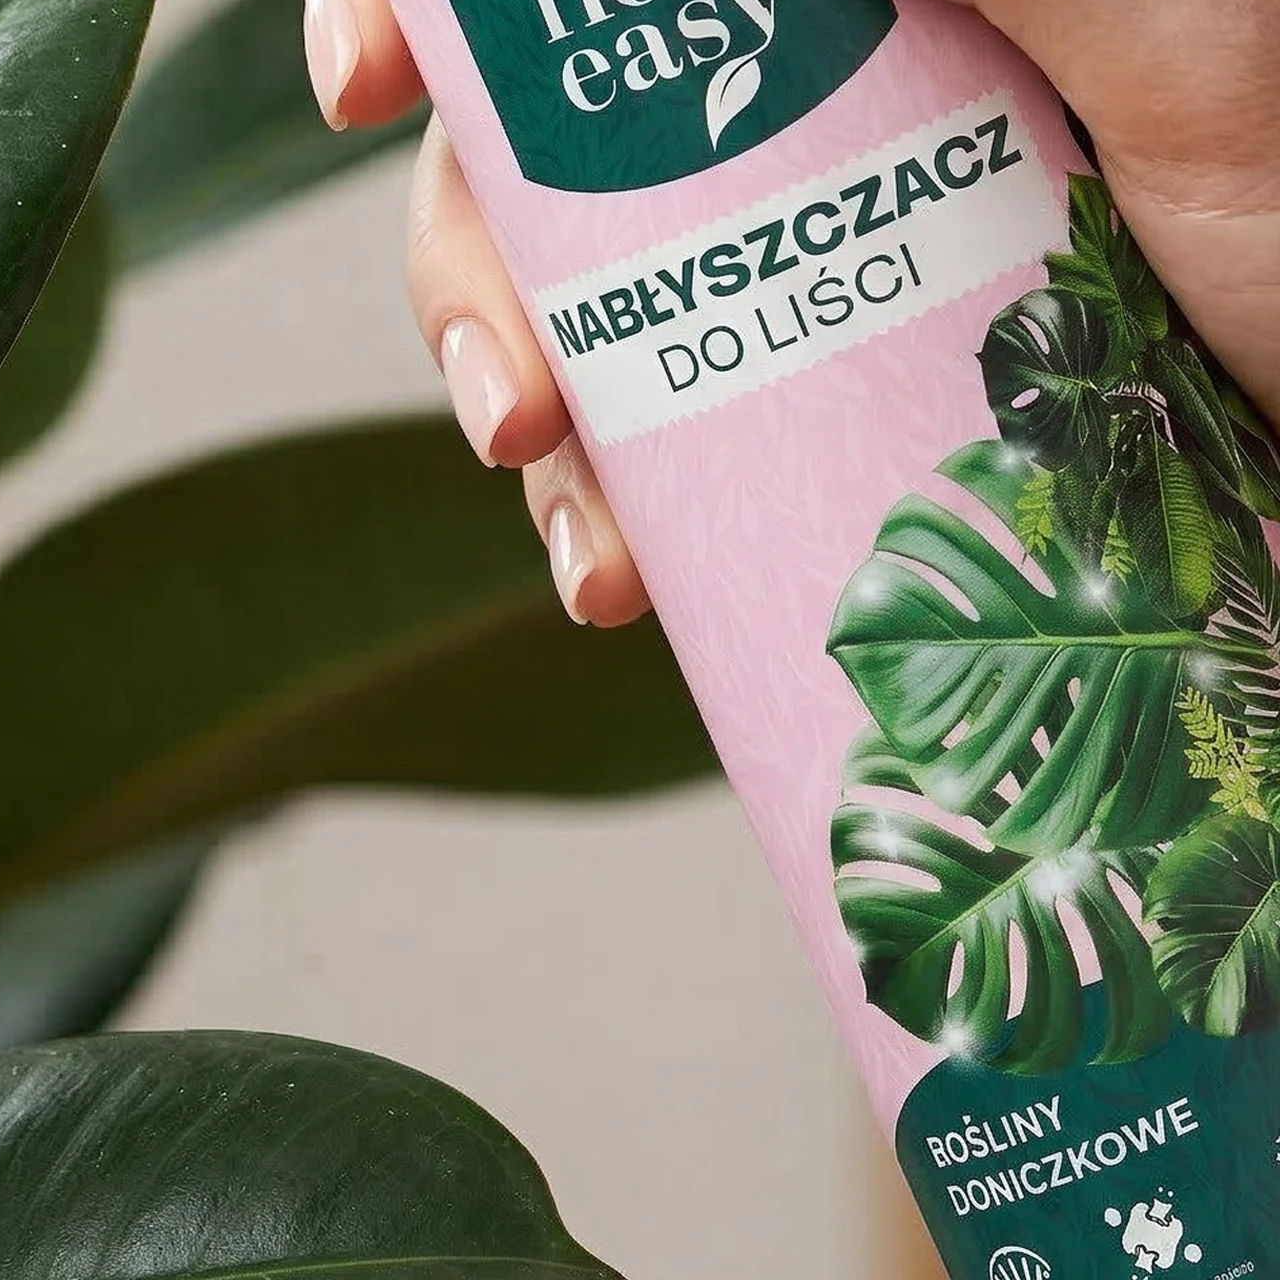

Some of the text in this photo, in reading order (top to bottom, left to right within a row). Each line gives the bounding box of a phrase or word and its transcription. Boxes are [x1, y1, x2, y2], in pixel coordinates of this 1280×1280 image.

[549, 114, 1023, 358] NABŁYSZCZACZ
[657, 243, 922, 393] DO LIŚCI
[947, 1097, 1199, 1217] DONICZKOWE
